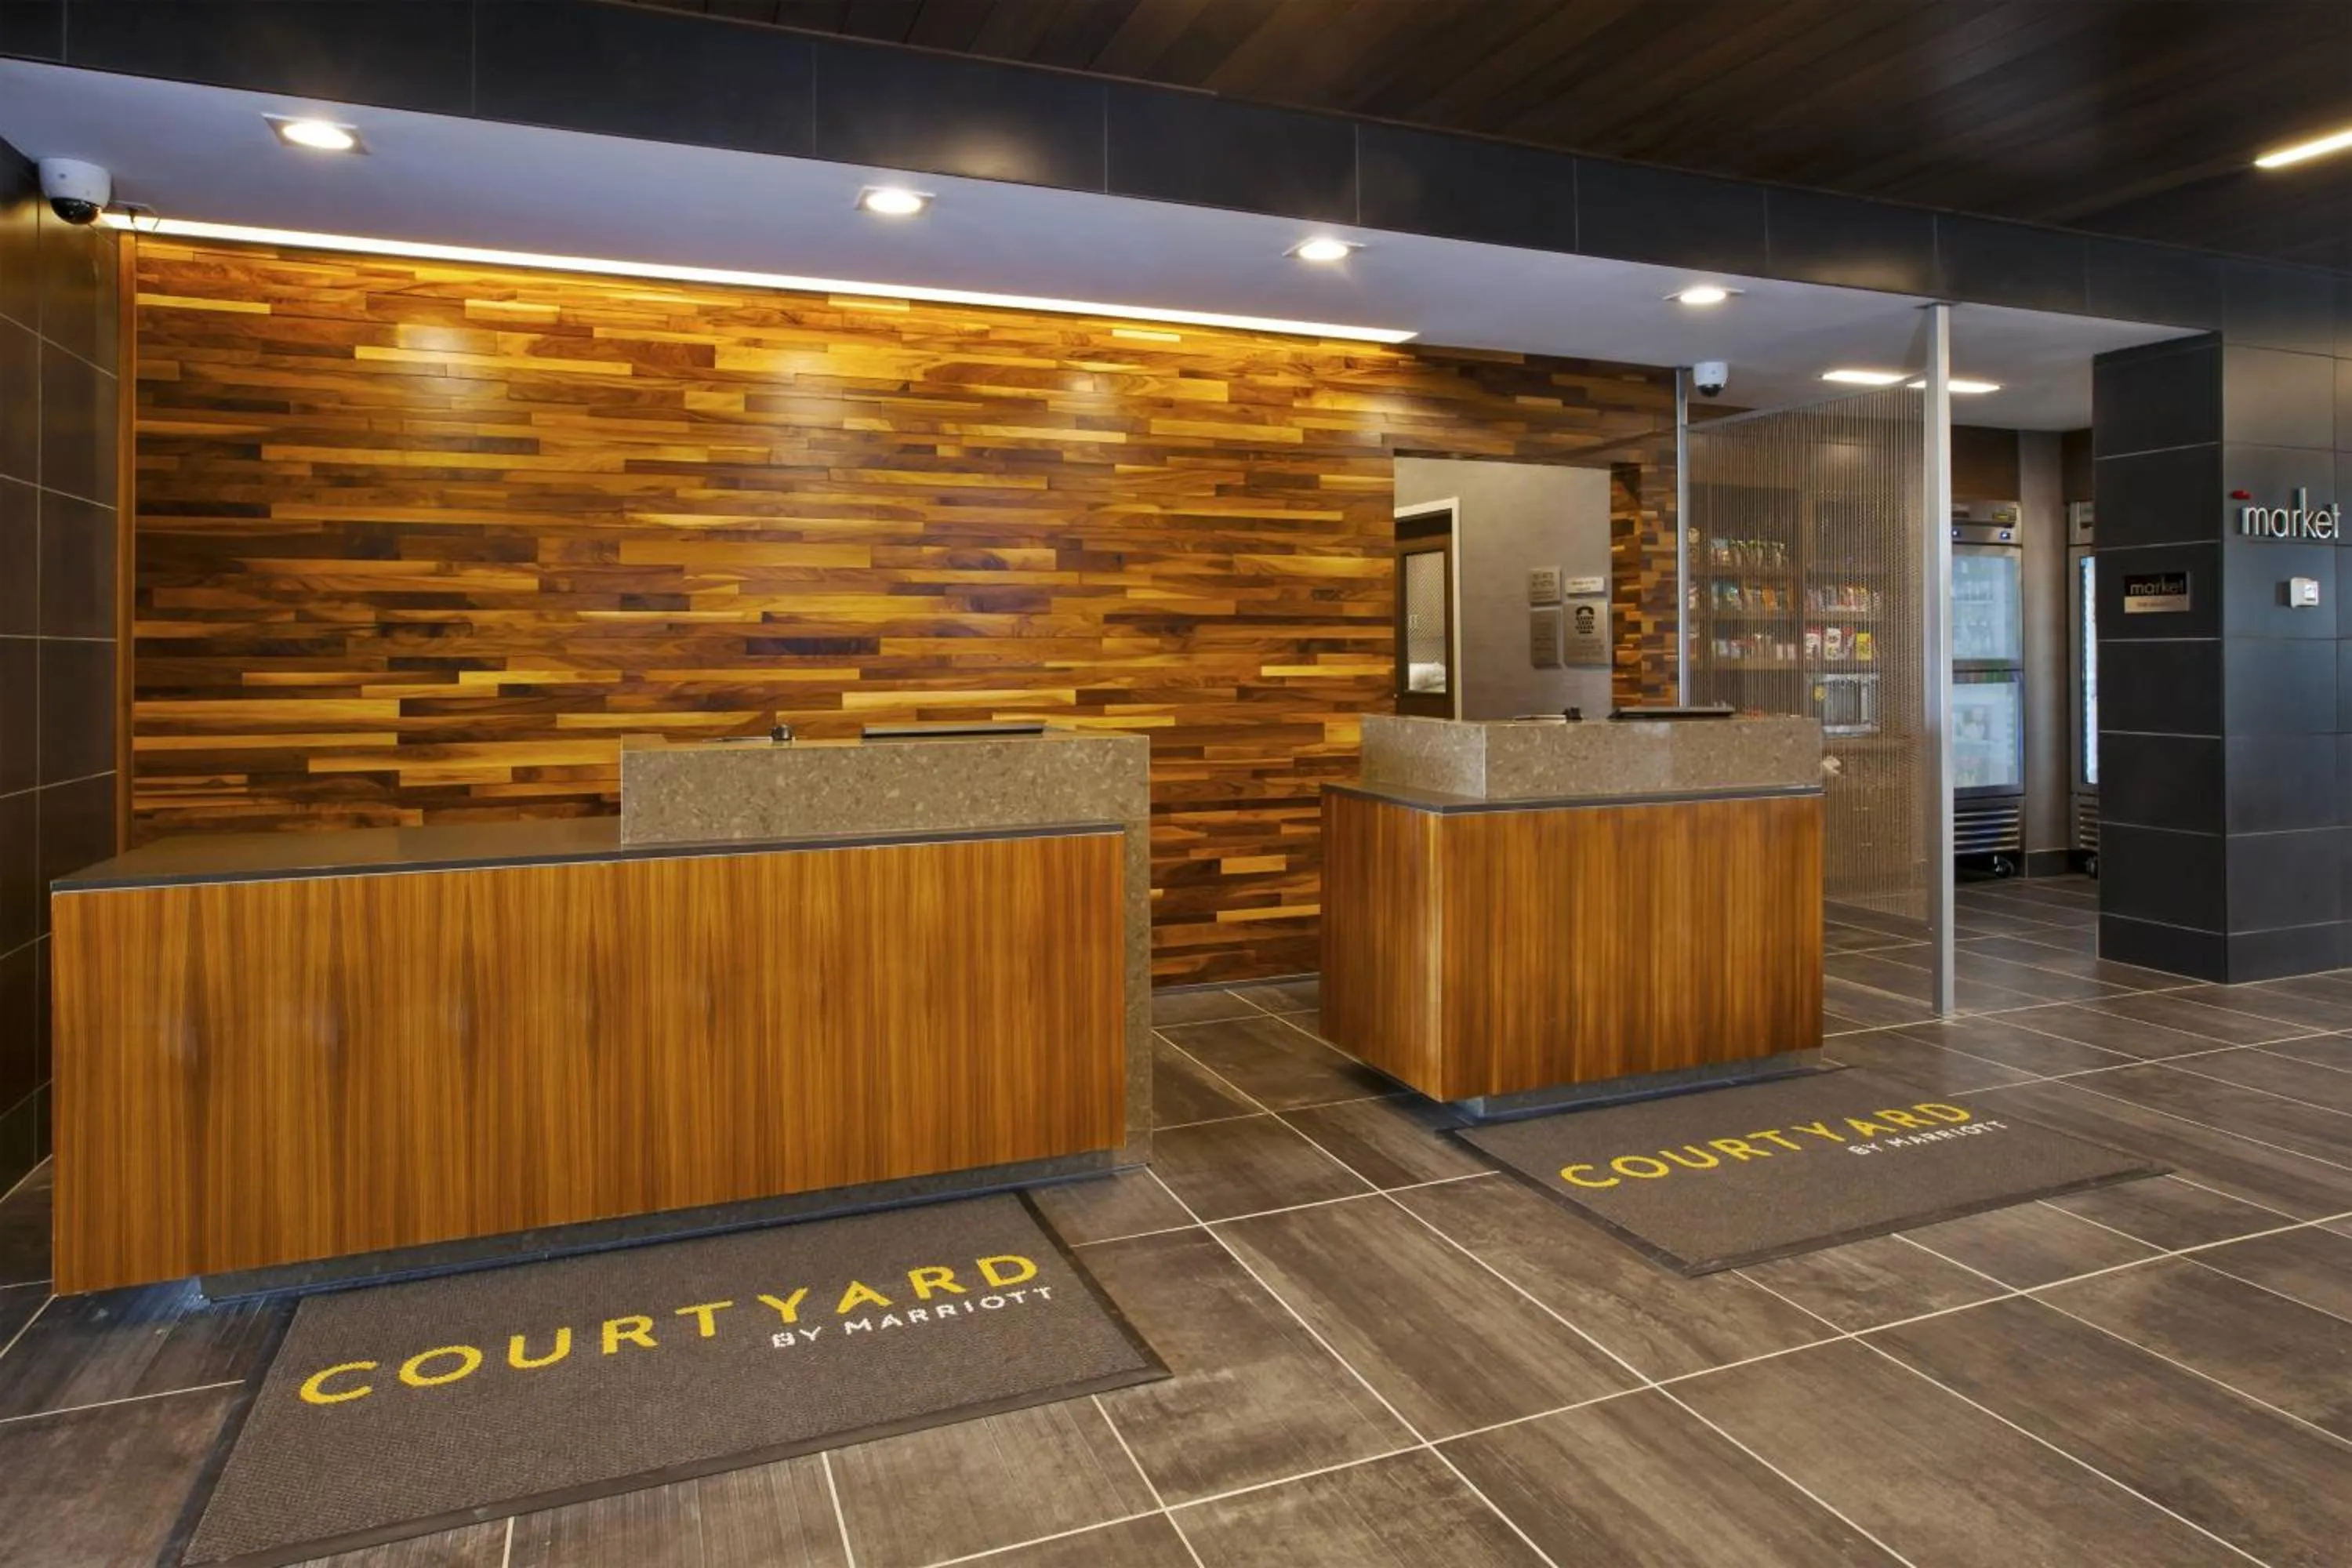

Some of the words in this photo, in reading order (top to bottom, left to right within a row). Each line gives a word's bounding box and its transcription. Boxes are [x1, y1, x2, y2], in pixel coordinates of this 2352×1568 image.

[2241, 487, 2340, 539] market
[2130, 576, 2183, 594] market
[1561, 1104, 1970, 1187] COURTYARD
[1847, 1143, 1882, 1156] BY
[1889, 1120, 2007, 1149] MARRIOTT
[299, 1254, 1038, 1405] COURTYARD
[772, 1327, 822, 1349] BY
[844, 1287, 1051, 1335] MARRIOTT
